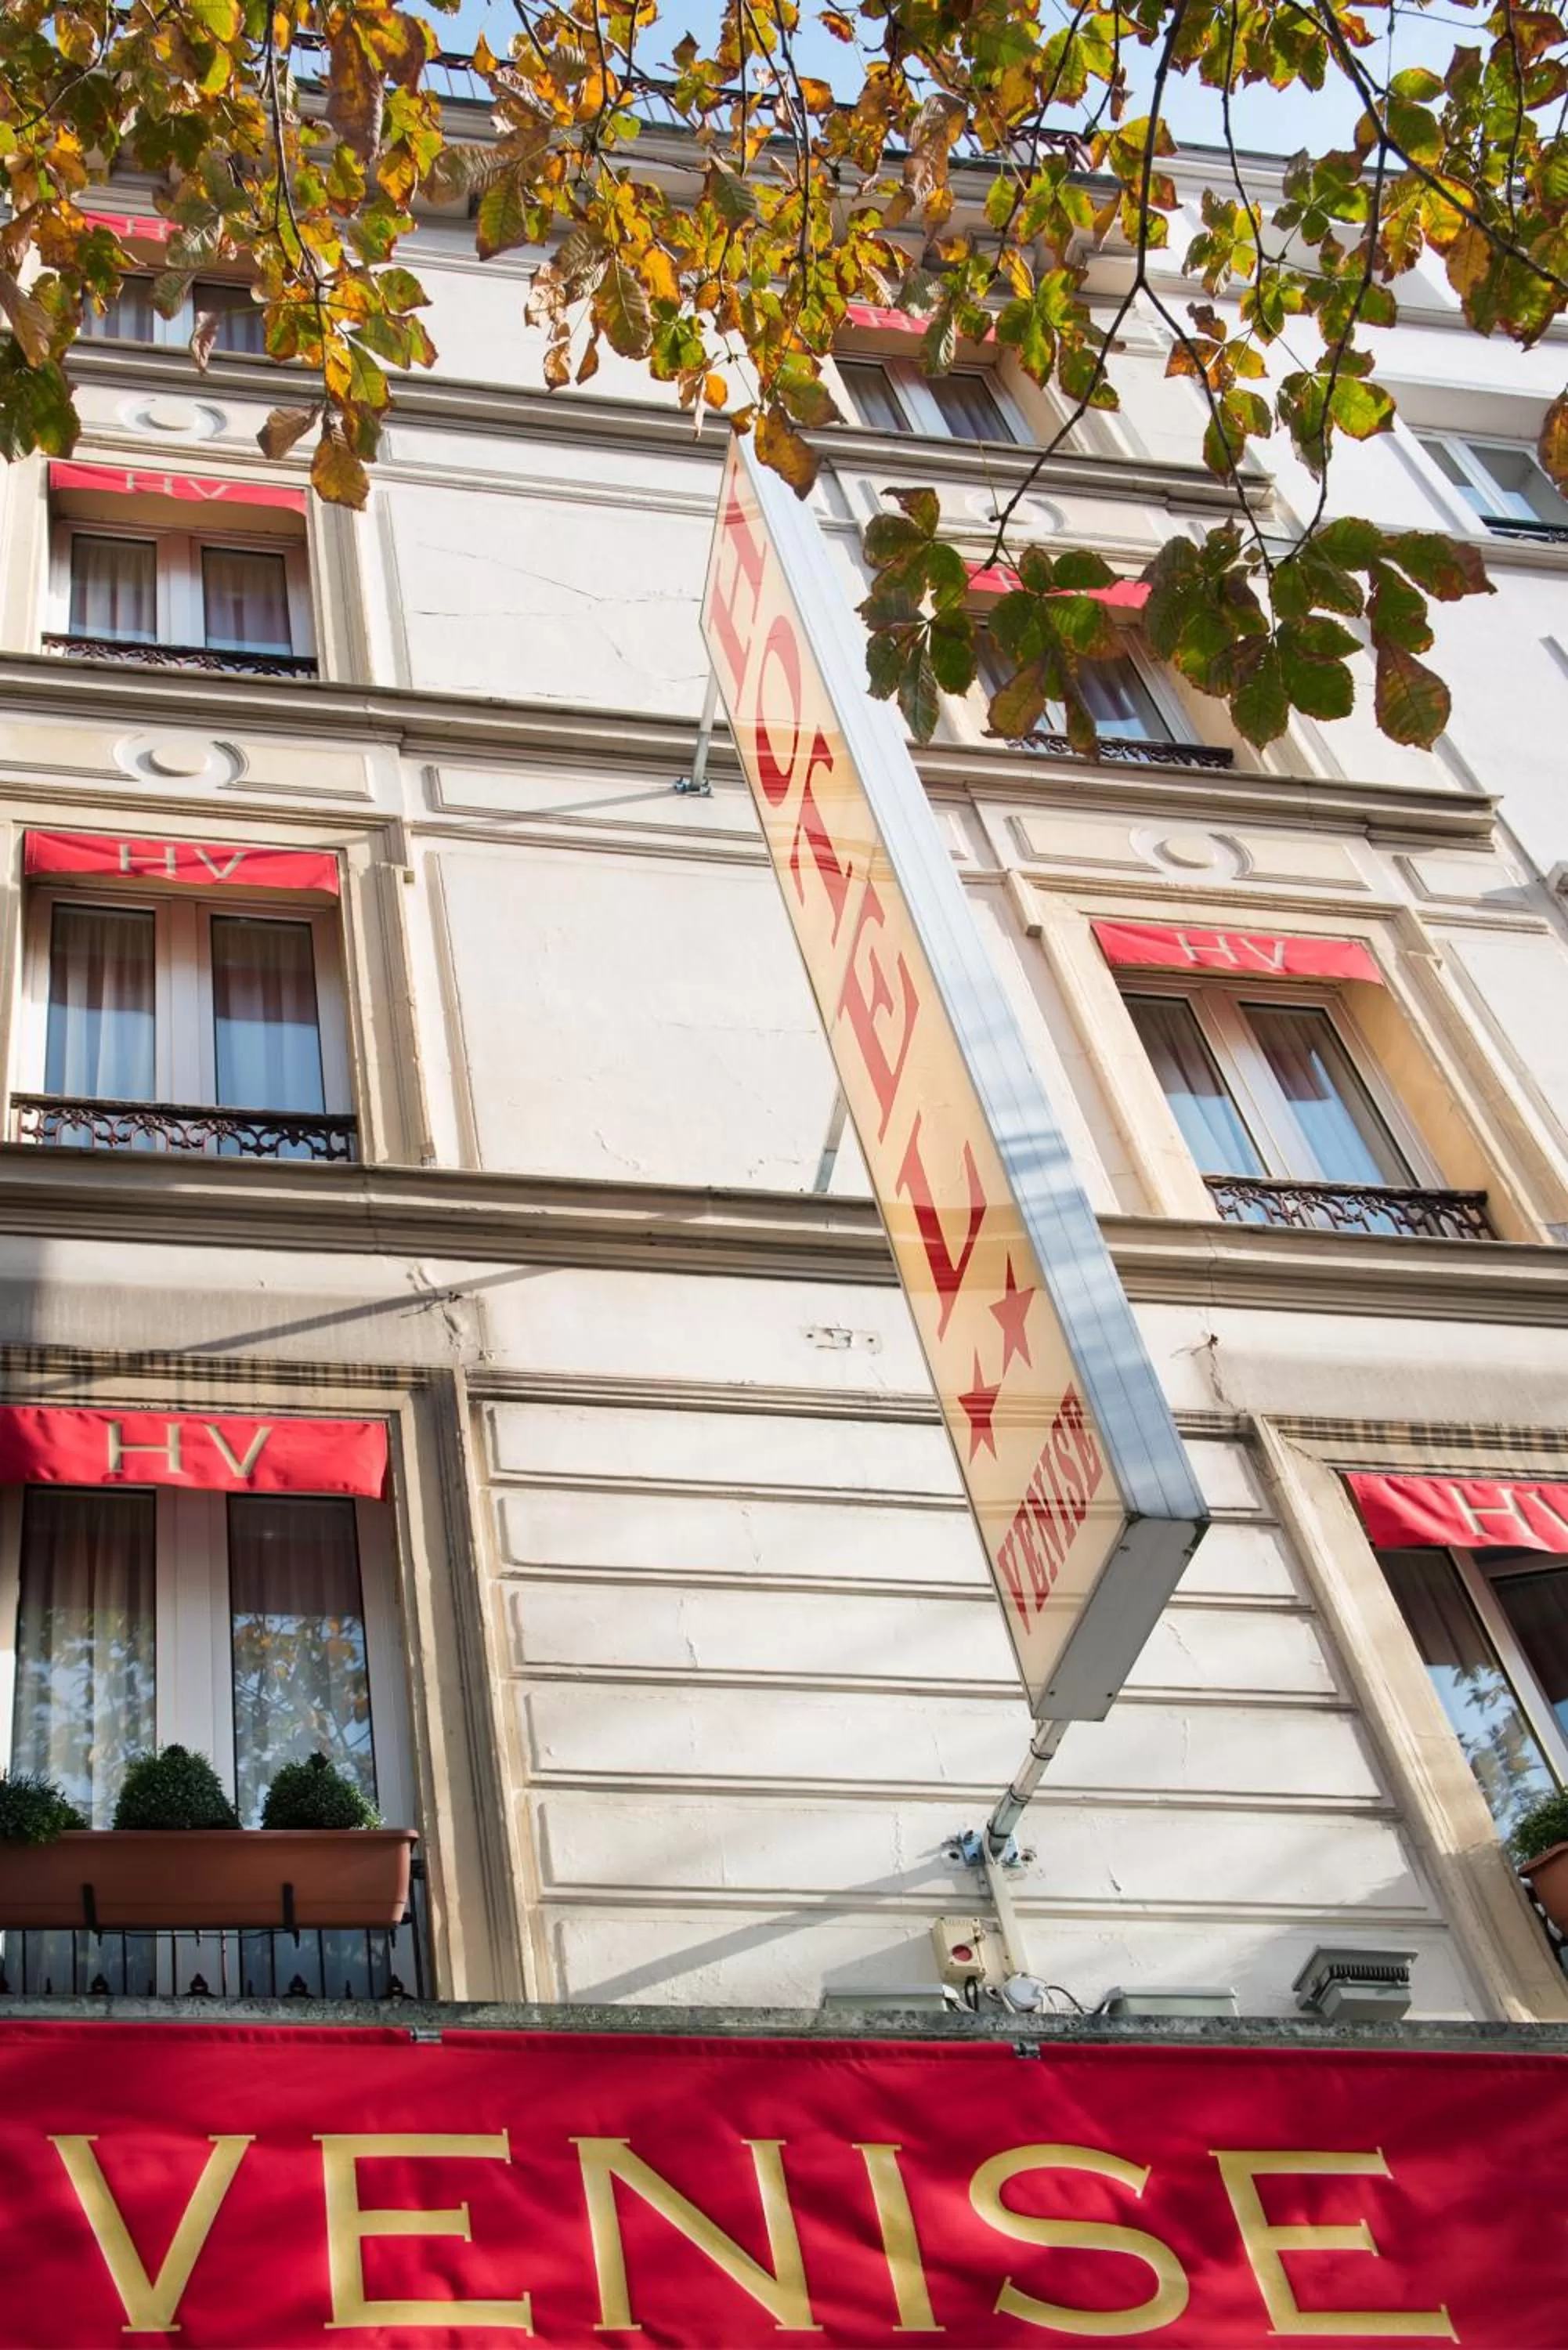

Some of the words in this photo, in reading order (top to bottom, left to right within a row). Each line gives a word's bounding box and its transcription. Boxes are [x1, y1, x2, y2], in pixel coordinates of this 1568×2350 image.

[126, 472, 231, 499] HV
[119, 843, 245, 879] HV
[708, 464, 987, 1343] HOTEL
[1177, 932, 1284, 970] HV
[107, 1419, 273, 1478] HV
[996, 1381, 1104, 1636] VENISE
[46, 2128, 1463, 2345] VENISE
